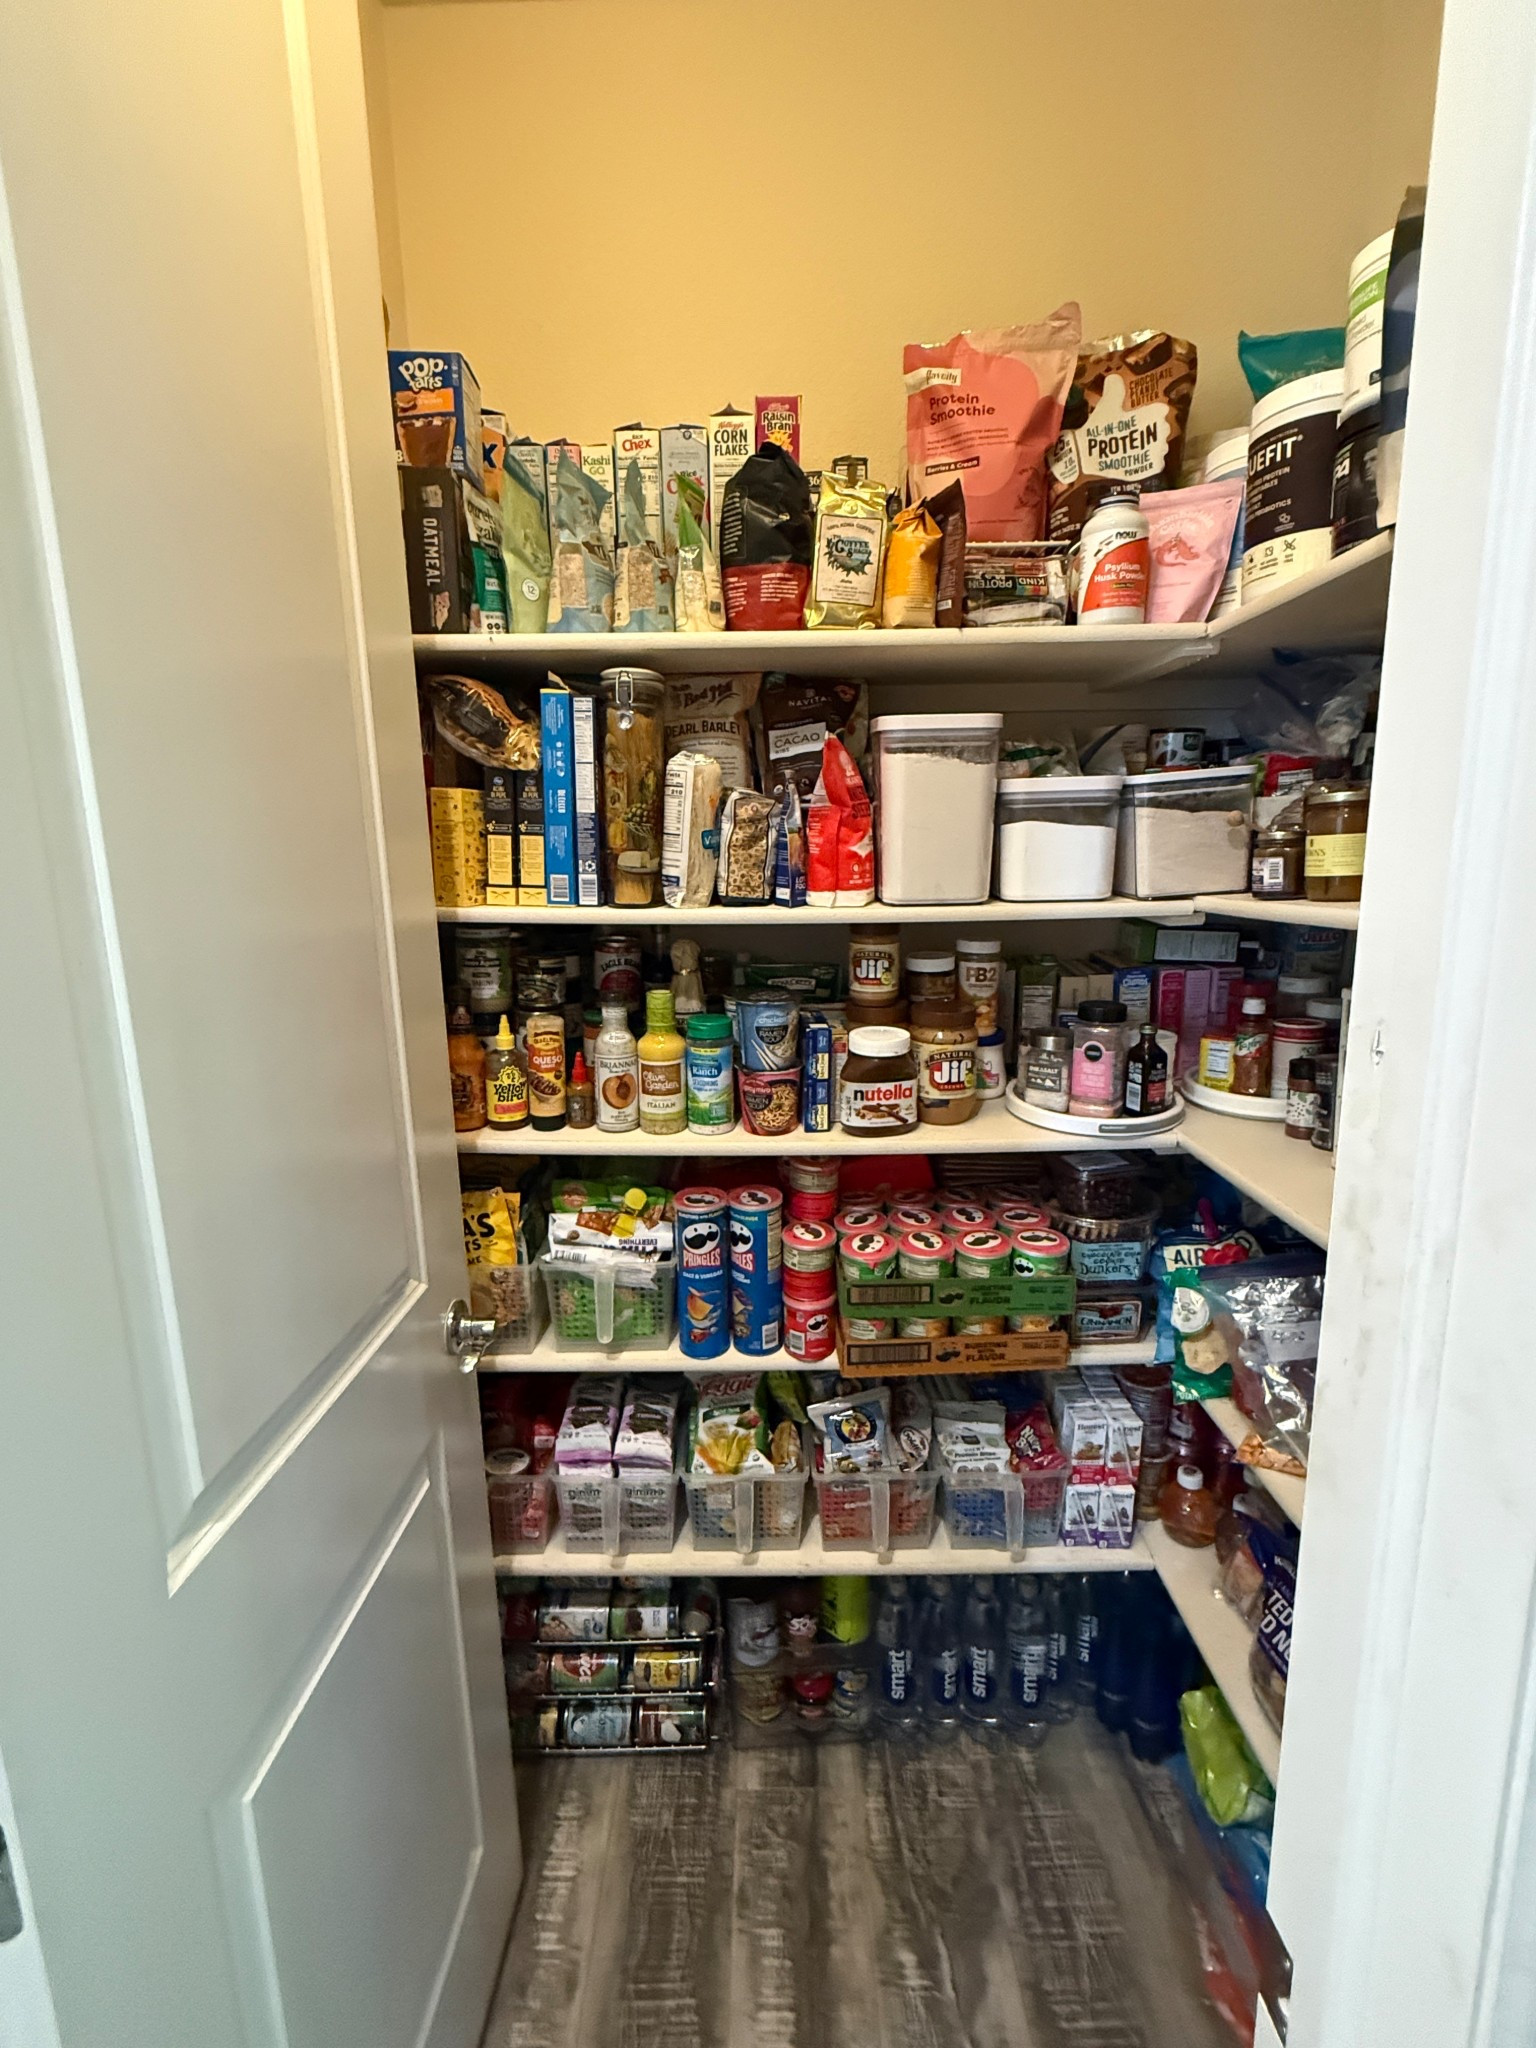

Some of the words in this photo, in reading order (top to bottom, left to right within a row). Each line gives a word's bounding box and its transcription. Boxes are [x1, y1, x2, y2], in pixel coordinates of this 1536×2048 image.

[409, 375, 442, 392] tarts
[1129, 367, 1174, 389] CHOCOLATE
[1129, 382, 1160, 398] PEANUT
[929, 393, 979, 410] Protein
[1130, 391, 1160, 408] BUTTER
[762, 411, 795, 424] Raisin
[930, 405, 995, 426] Smoothie
[766, 421, 792, 432] Bran
[1086, 415, 1137, 438] ALL-IN-ONE
[714, 429, 747, 443] CORN
[1087, 422, 1158, 459] PROTEIN
[622, 438, 652, 452] Chex
[714, 444, 749, 456] FLAKES
[583, 456, 610, 466] Kashi
[927, 465, 949, 474] Berries
[957, 460, 978, 468] Cream
[1098, 449, 1150, 472] SMOOTHIE
[589, 467, 605, 475] GO
[1124, 462, 1154, 477] POWDER
[422, 517, 441, 587] OATMEAL
[1105, 562, 1141, 575] Psyllium
[968, 579, 1013, 588] PROTEIN
[1019, 577, 1045, 585] KIND
[1094, 572, 1118, 582] Husk
[774, 732, 820, 749] CACAO
[855, 951, 890, 959] NATURAL
[855, 959, 890, 979] Jif
[965, 966, 997, 983] PB2
[533, 1055, 562, 1065] QUESO
[933, 1050, 973, 1060] NATURAL
[643, 1070, 667, 1082] Olive
[692, 1066, 718, 1076] Ranch
[932, 1059, 972, 1084] Jif
[645, 1079, 680, 1092] Garden
[853, 1083, 913, 1101] nutella
[498, 1091, 524, 1102] bird
[647, 1101, 676, 1109] ITALIAN
[683, 1248, 721, 1268] PRINGLES
[1080, 1262, 1133, 1276] Dunkers
[966, 1353, 1006, 1361] FLAVOR
[697, 1376, 757, 1401] Veggie
[888, 1649, 905, 1700] smart
[970, 1646, 986, 1698] smart
